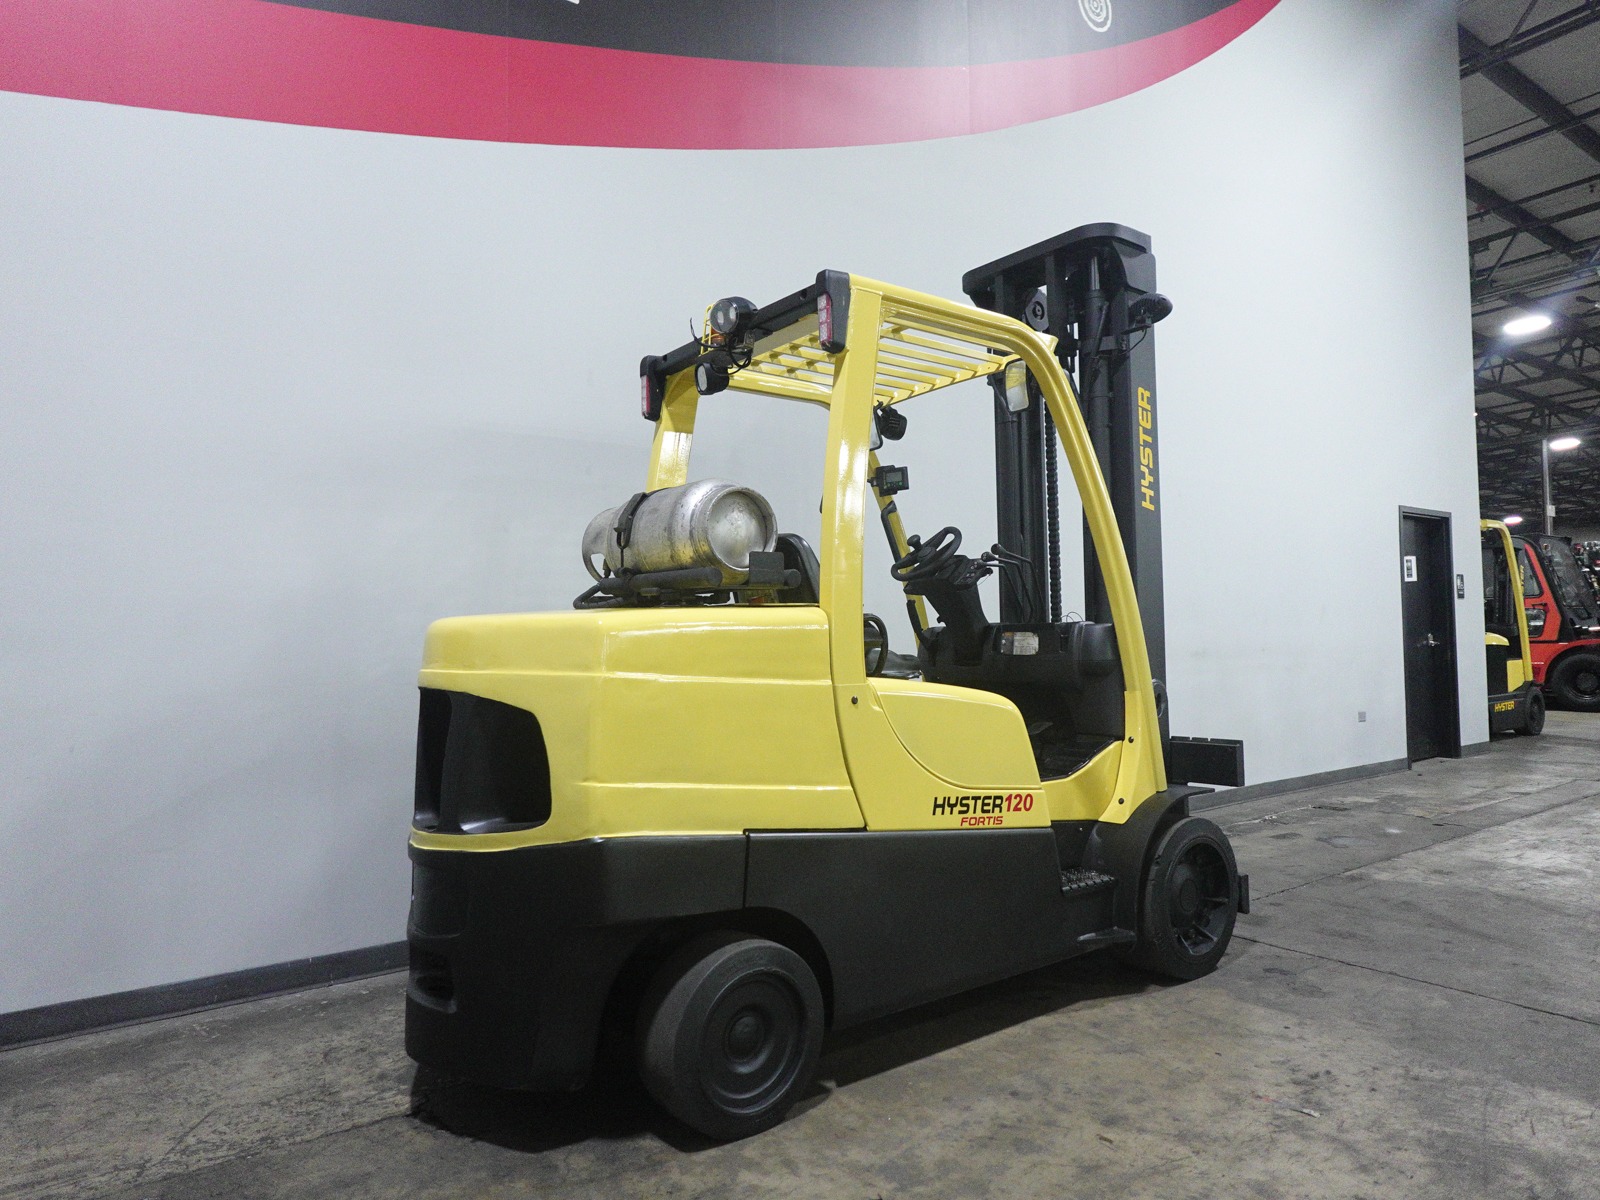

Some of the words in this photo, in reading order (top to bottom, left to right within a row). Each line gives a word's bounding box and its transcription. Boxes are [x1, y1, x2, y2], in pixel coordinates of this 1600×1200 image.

[1137, 387, 1155, 511] HYSTER
[1494, 700, 1515, 712] HYSTER
[932, 795, 1004, 816] HYSTER
[1004, 793, 1034, 812] 120
[960, 816, 1004, 827] FORTIS
